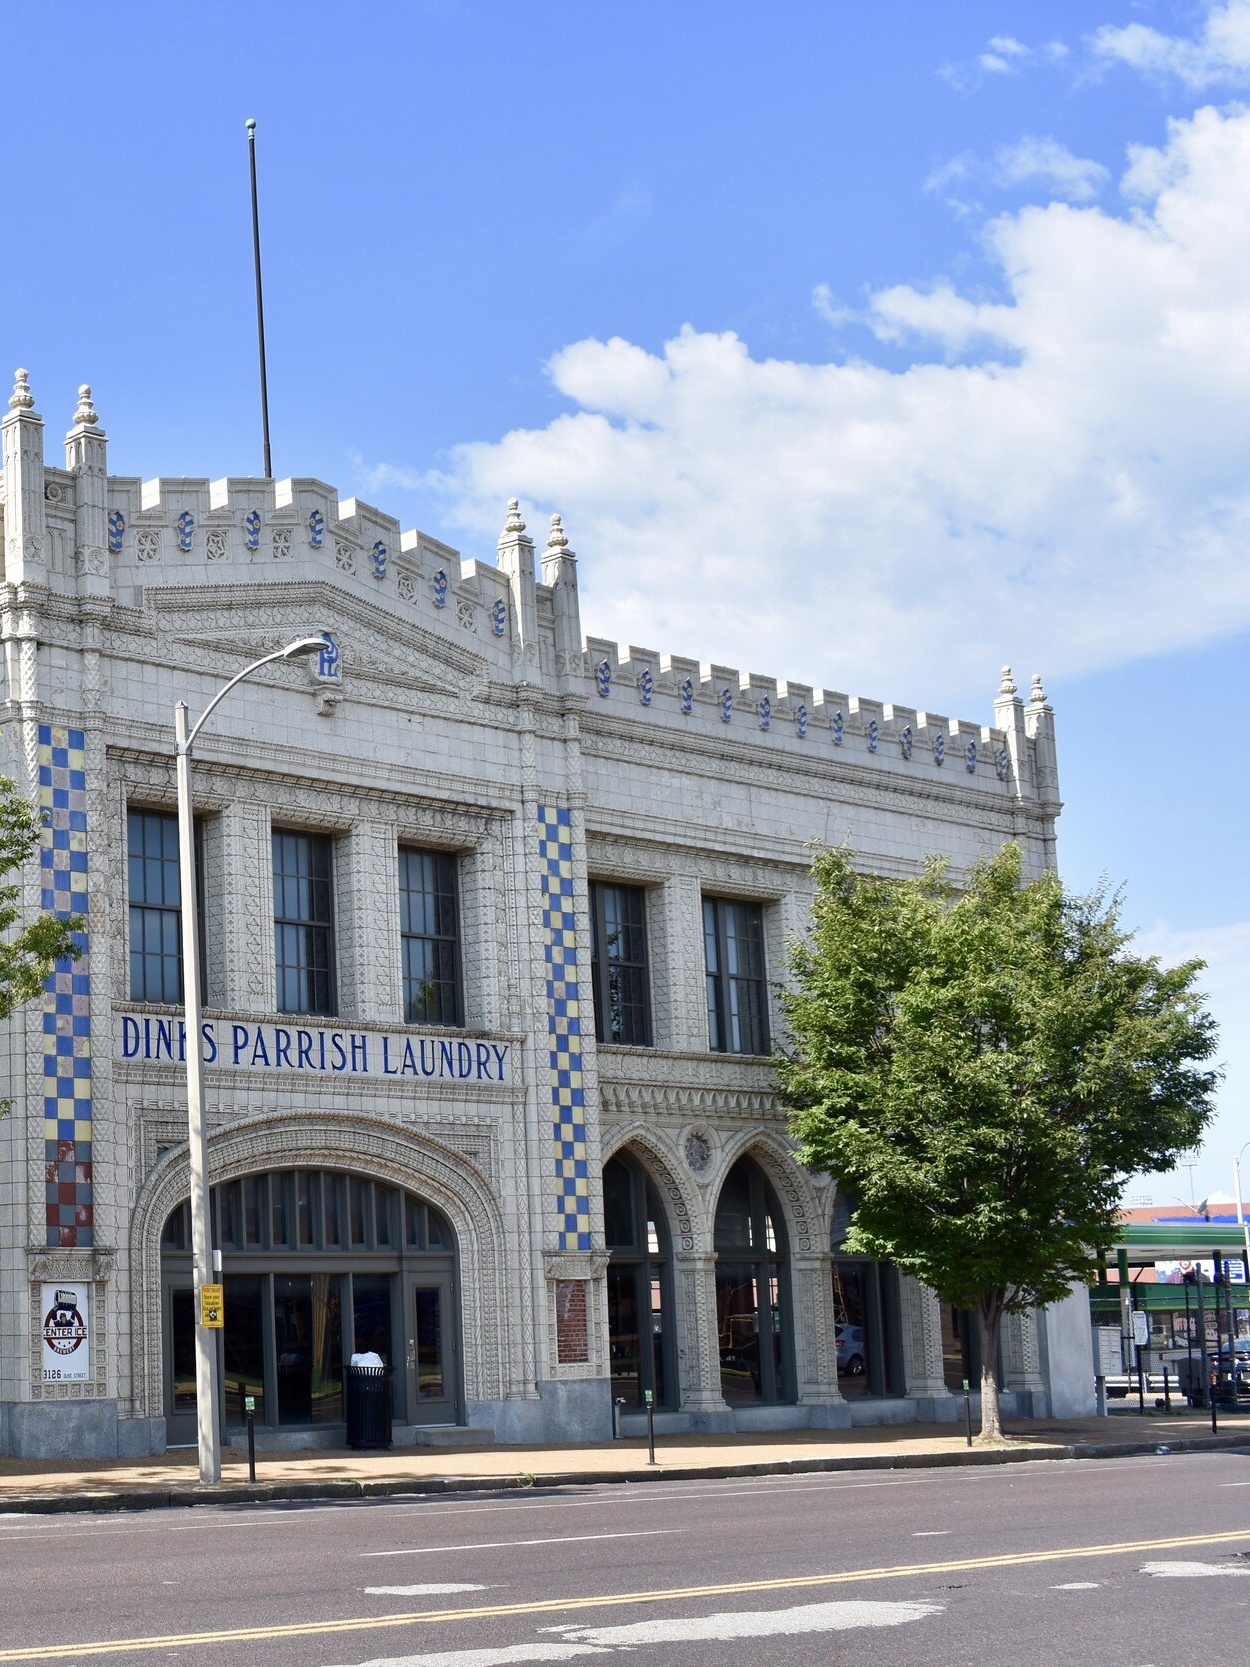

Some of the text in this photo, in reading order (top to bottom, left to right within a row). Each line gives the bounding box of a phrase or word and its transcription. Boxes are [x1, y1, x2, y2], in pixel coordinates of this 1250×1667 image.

[232, 1024, 369, 1072] PARRISH
[381, 1036, 510, 1081] LAUNDRY
[44, 1328, 87, 1336] ENTER ICE
[43, 1369, 62, 1379] 3126
